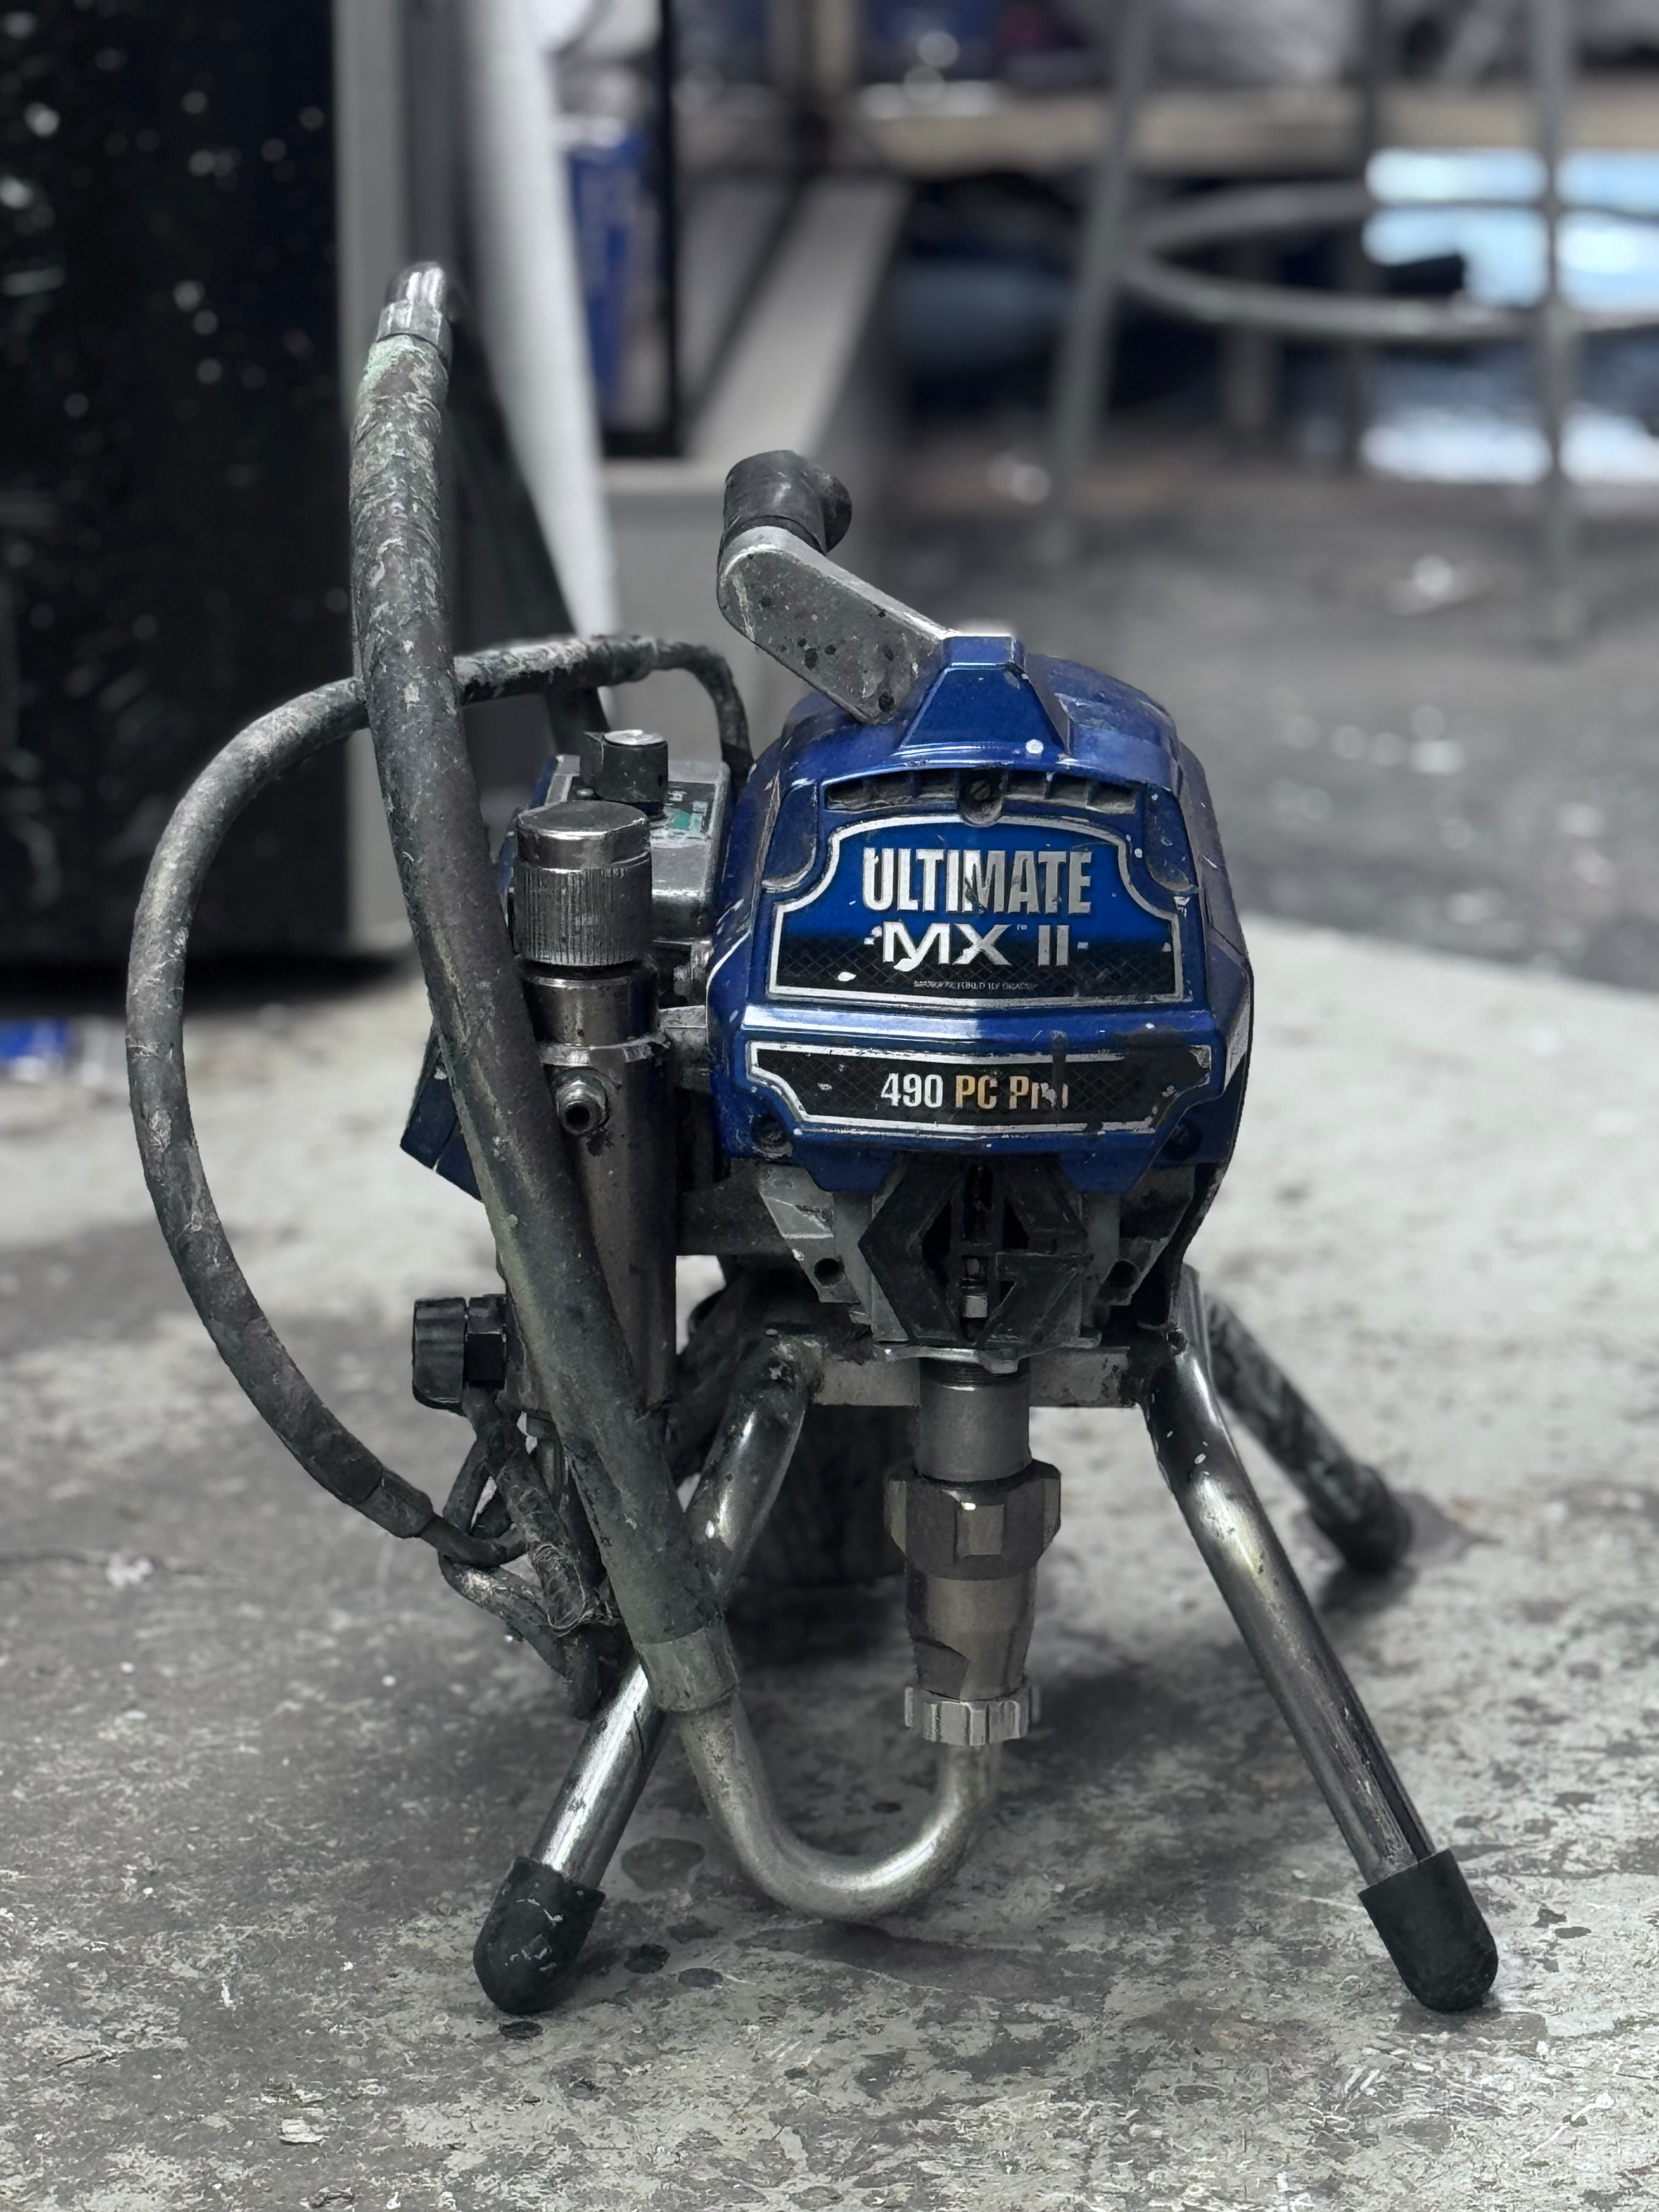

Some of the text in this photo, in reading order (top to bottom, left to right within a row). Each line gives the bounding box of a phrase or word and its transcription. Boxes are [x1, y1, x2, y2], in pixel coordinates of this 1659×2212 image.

[863, 847, 1092, 914] ULTIMATE
[883, 921, 1069, 966] MX II
[881, 1073, 943, 1108] 490
[956, 1075, 997, 1109] PC
